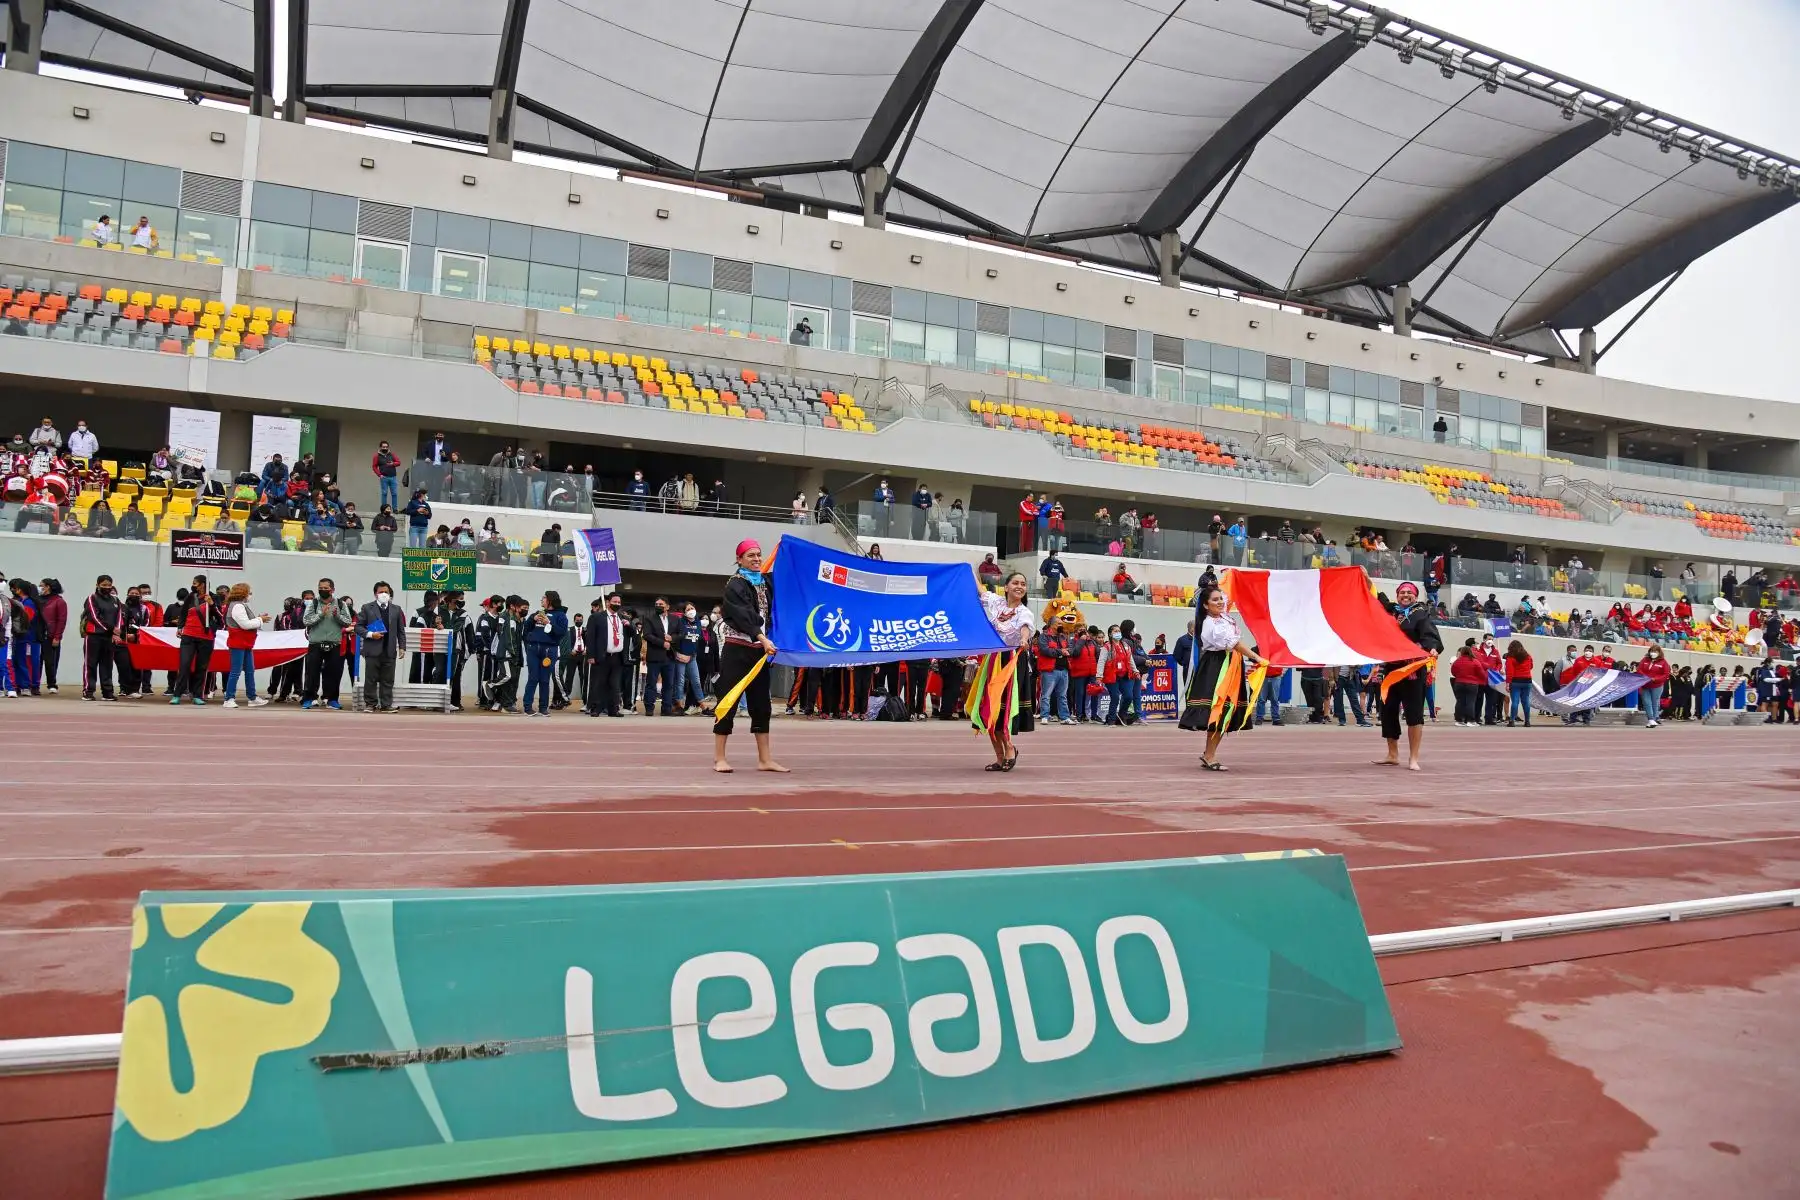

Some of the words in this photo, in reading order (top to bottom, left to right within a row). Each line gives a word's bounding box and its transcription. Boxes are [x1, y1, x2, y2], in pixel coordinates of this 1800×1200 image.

[595, 550, 608, 562] UGEL
[868, 610, 949, 635] JUEGOS
[869, 623, 953, 645] ESCOLARES
[871, 631, 956, 652] DEPORTIVOS
[1156, 677, 1168, 687] 04
[1141, 702, 1176, 711] FAMILIA
